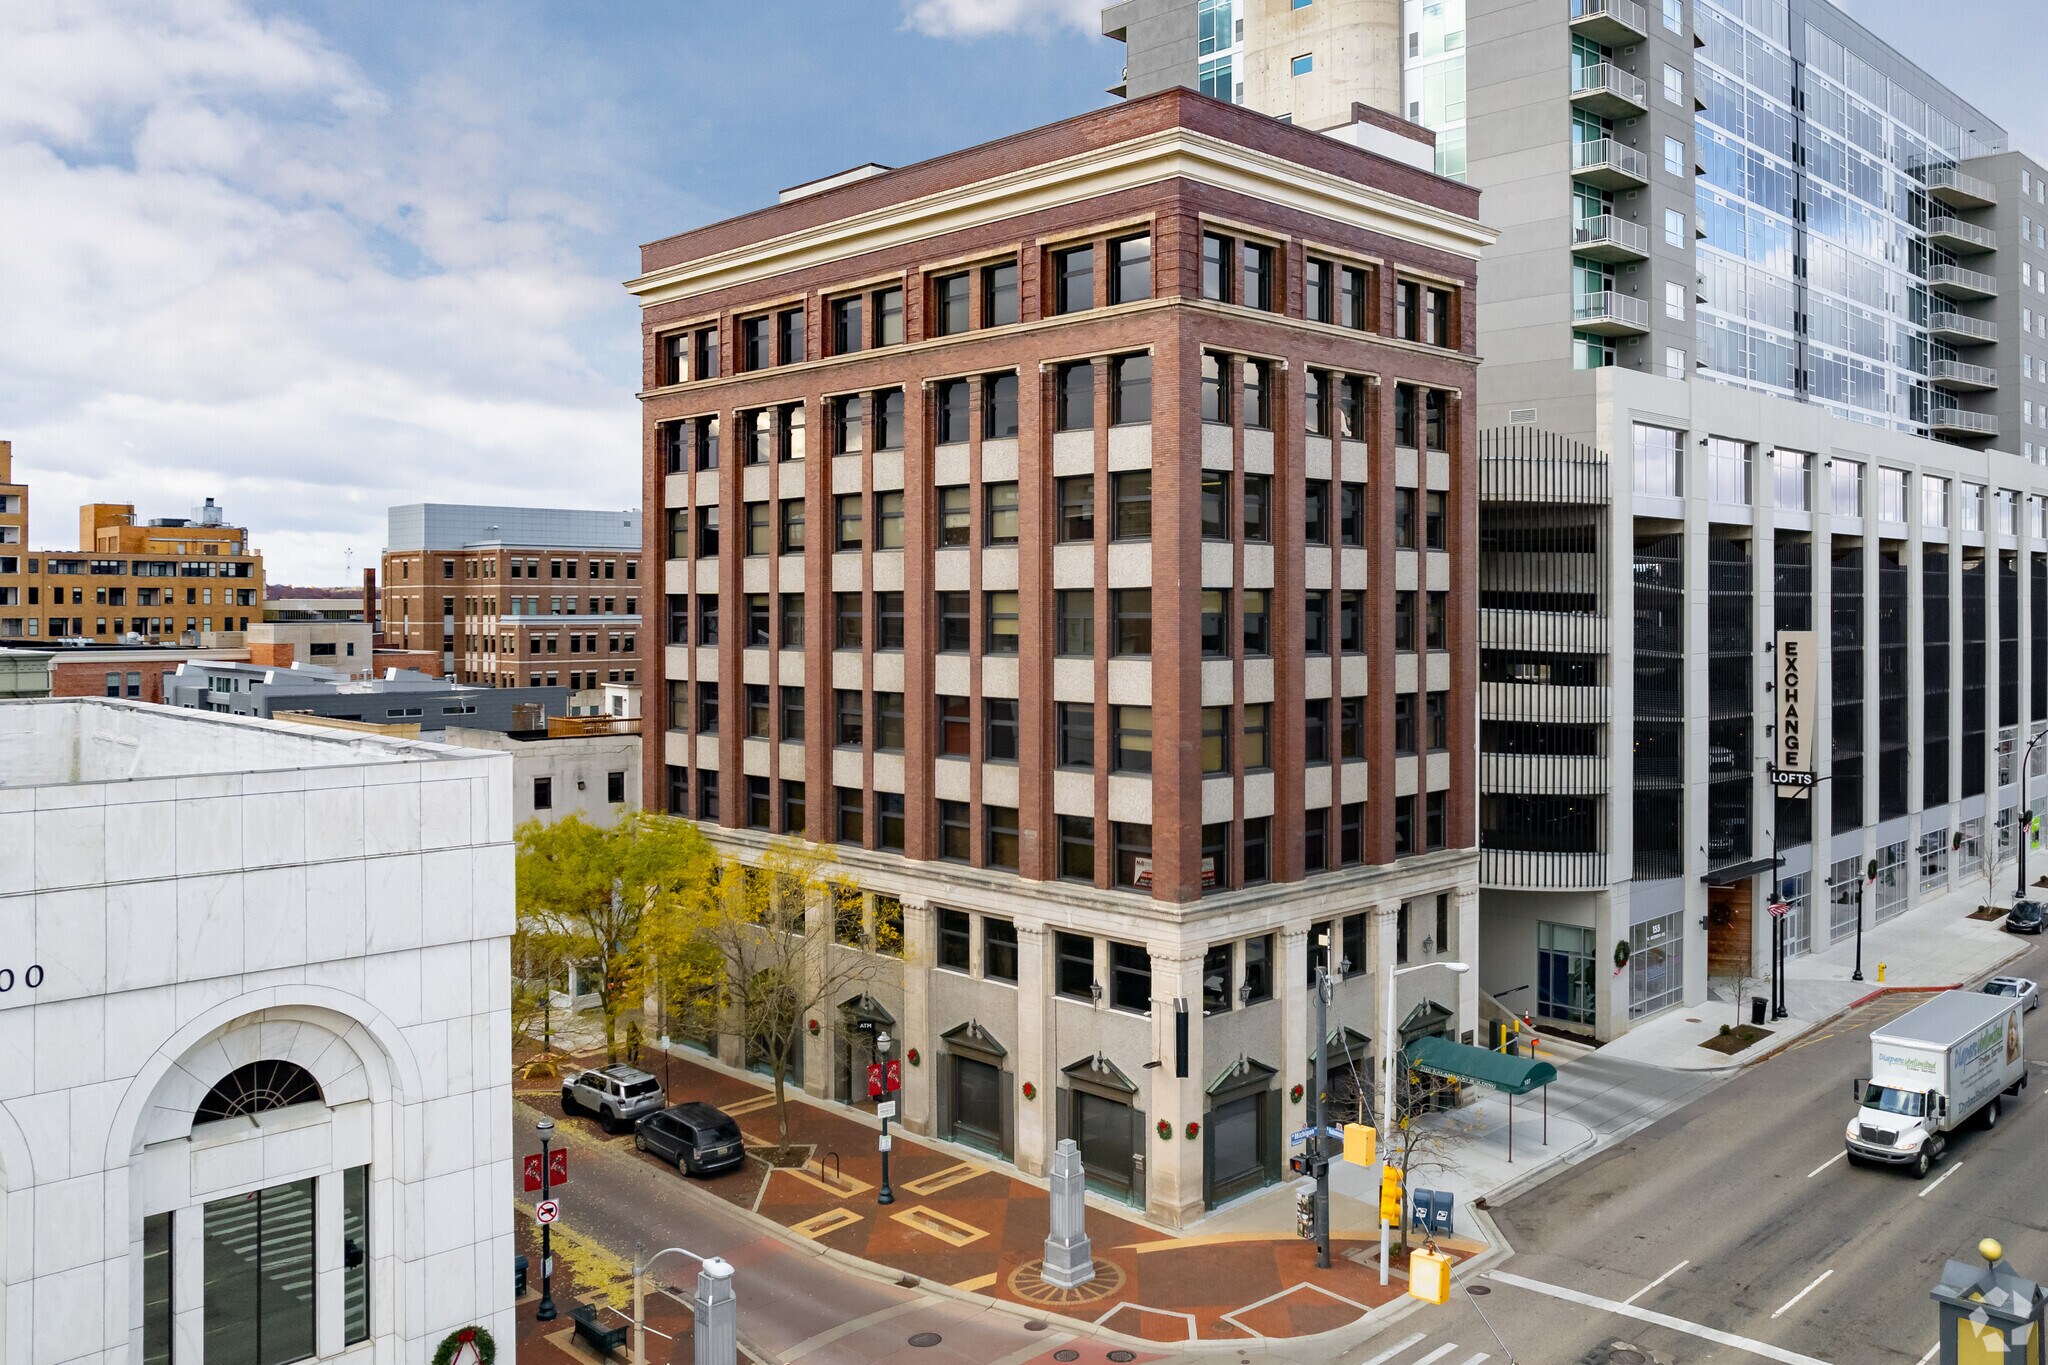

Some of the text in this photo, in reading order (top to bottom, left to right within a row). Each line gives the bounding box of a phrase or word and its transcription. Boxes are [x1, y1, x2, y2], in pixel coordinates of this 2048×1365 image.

[1785, 641, 1799, 766] EXCHANGE
[1772, 772, 1812, 785] LOFTS
[1652, 924, 1661, 934] 155
[1432, 1067, 1469, 1083] KALAMZOO
[1469, 1078, 1497, 1090] BUILDING
[1294, 1129, 1315, 1140] Michigan
